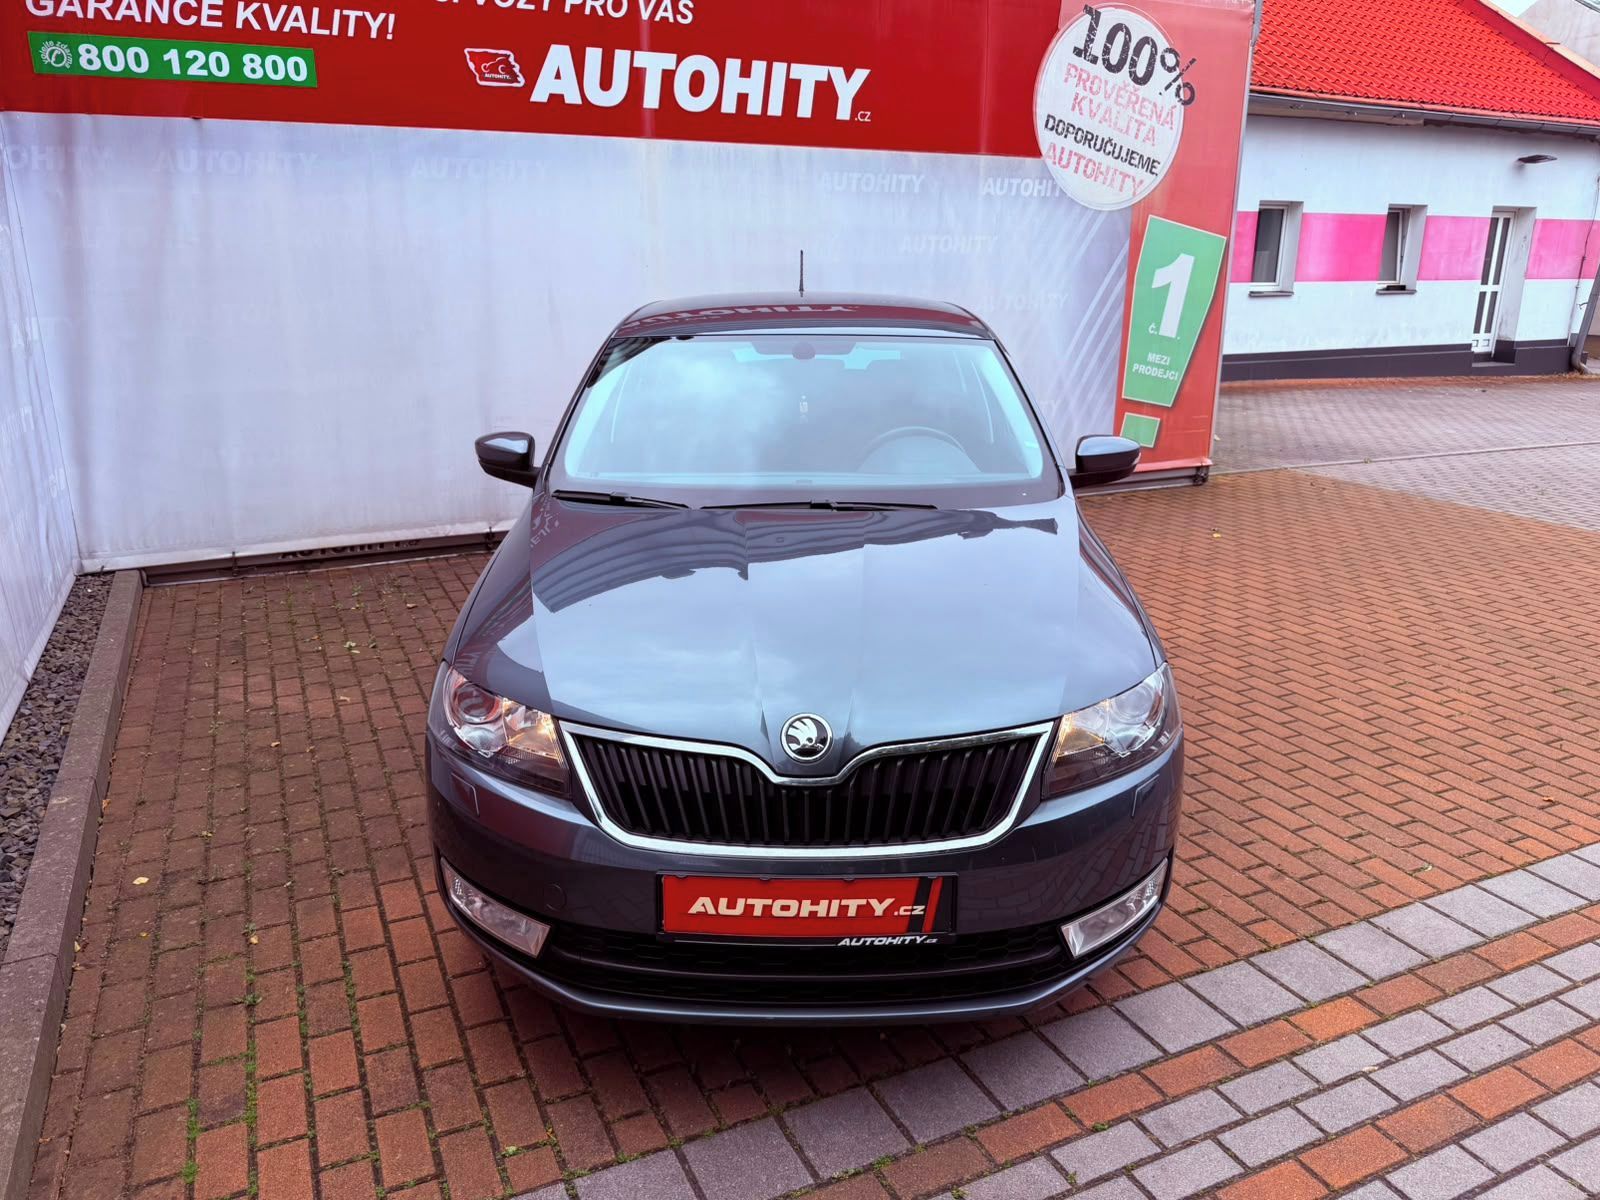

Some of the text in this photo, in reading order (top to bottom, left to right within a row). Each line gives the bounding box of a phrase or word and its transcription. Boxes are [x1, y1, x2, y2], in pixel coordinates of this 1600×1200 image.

[26, 0, 396, 40] GARANCE KVALITY!
[77, 43, 308, 82] 800 120 800
[1072, 4, 1197, 106] 100%
[1063, 62, 1178, 131] PROVĚŘENÁ
[1070, 91, 1159, 147] KVALITA
[1043, 113, 1162, 177] DOPORUČUJEME
[1044, 142, 1145, 197] AUTOHITY
[1132, 364, 1178, 381] PRODEJCI
[1147, 352, 1170, 366] MEZI
